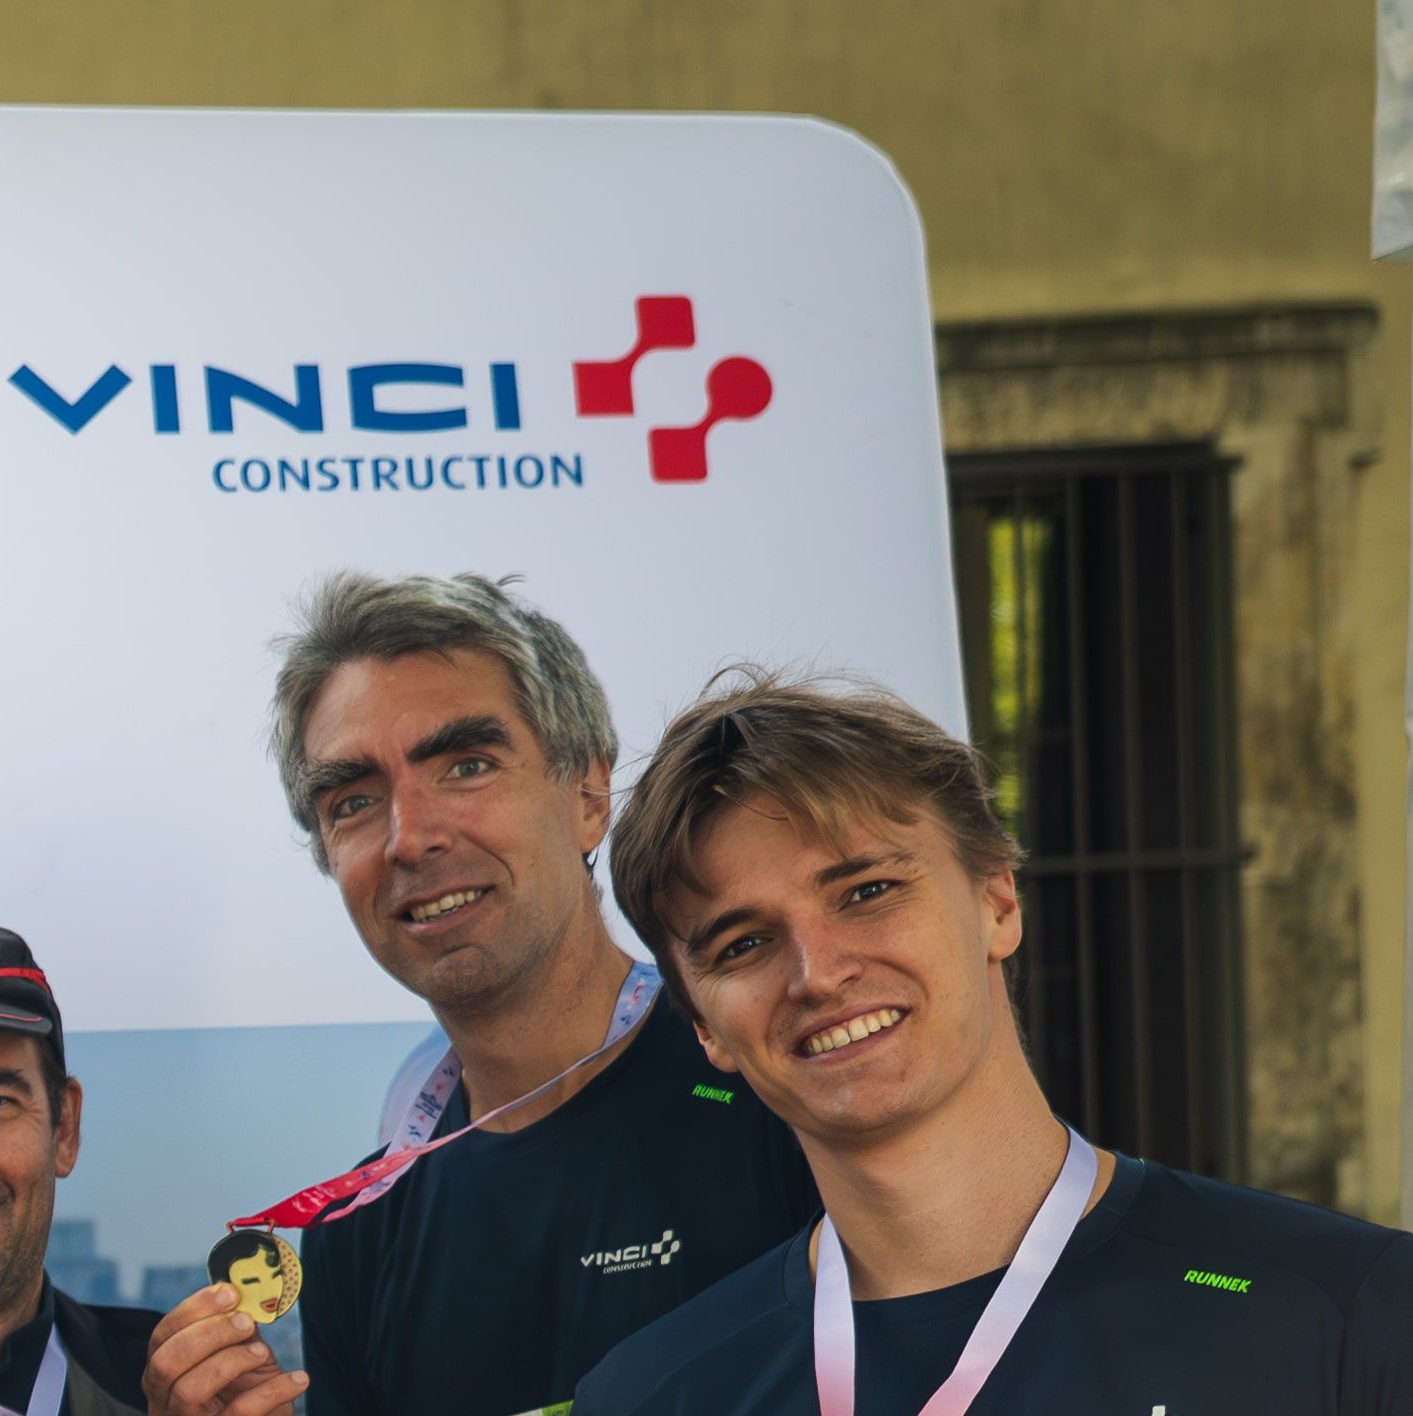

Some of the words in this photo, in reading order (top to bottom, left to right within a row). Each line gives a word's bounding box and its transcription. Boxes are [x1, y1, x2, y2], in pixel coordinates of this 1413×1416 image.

[7, 362, 524, 436] VINCI
[211, 452, 584, 494] CONSTRUCTION
[580, 1245, 647, 1267] VINCI
[1184, 1270, 1252, 1294] RUNNEK
